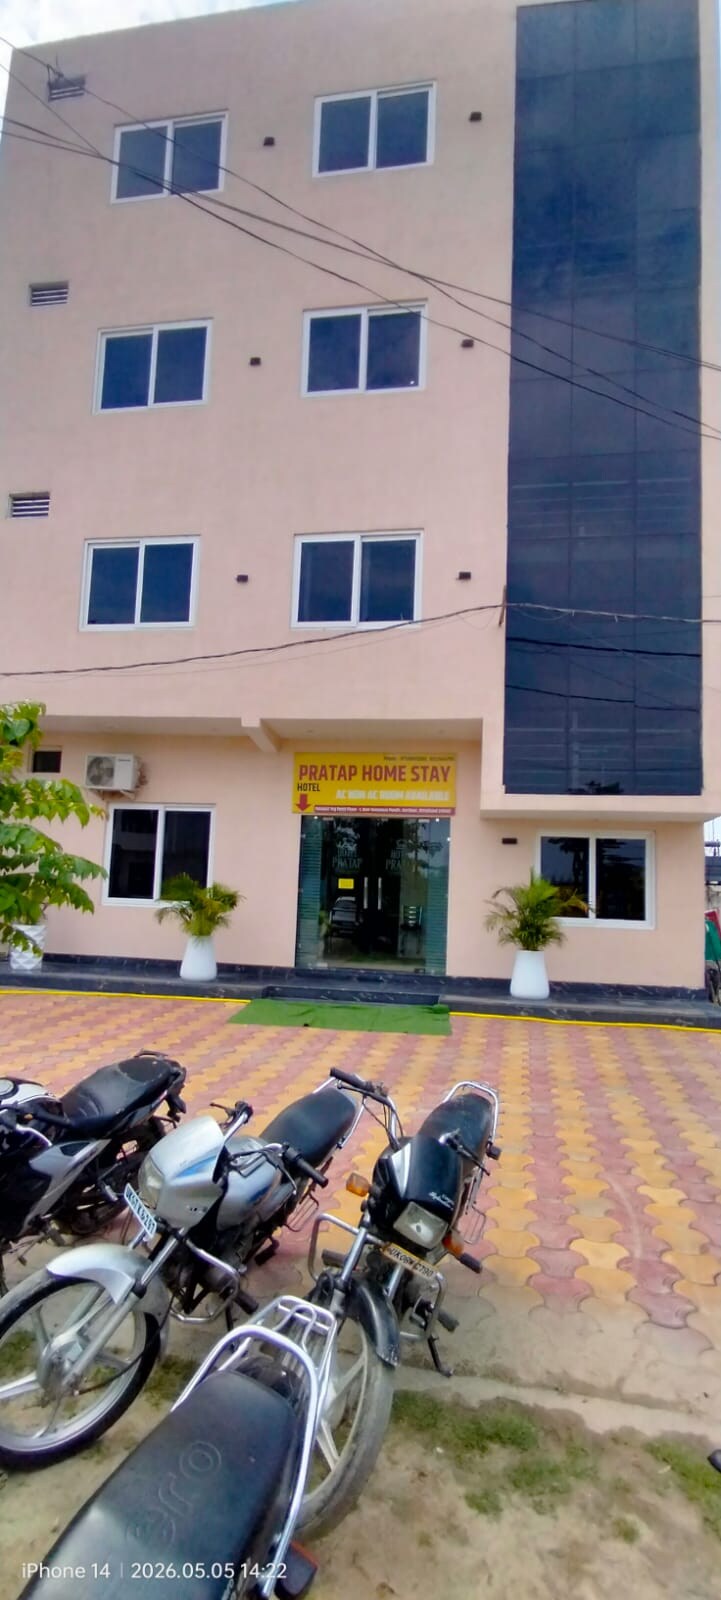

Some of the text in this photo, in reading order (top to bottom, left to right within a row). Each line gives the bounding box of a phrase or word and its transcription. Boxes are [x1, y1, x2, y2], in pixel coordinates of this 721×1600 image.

[299, 764, 451, 782] PRATAP HOME STAY
[297, 782, 320, 792] HOTEL
